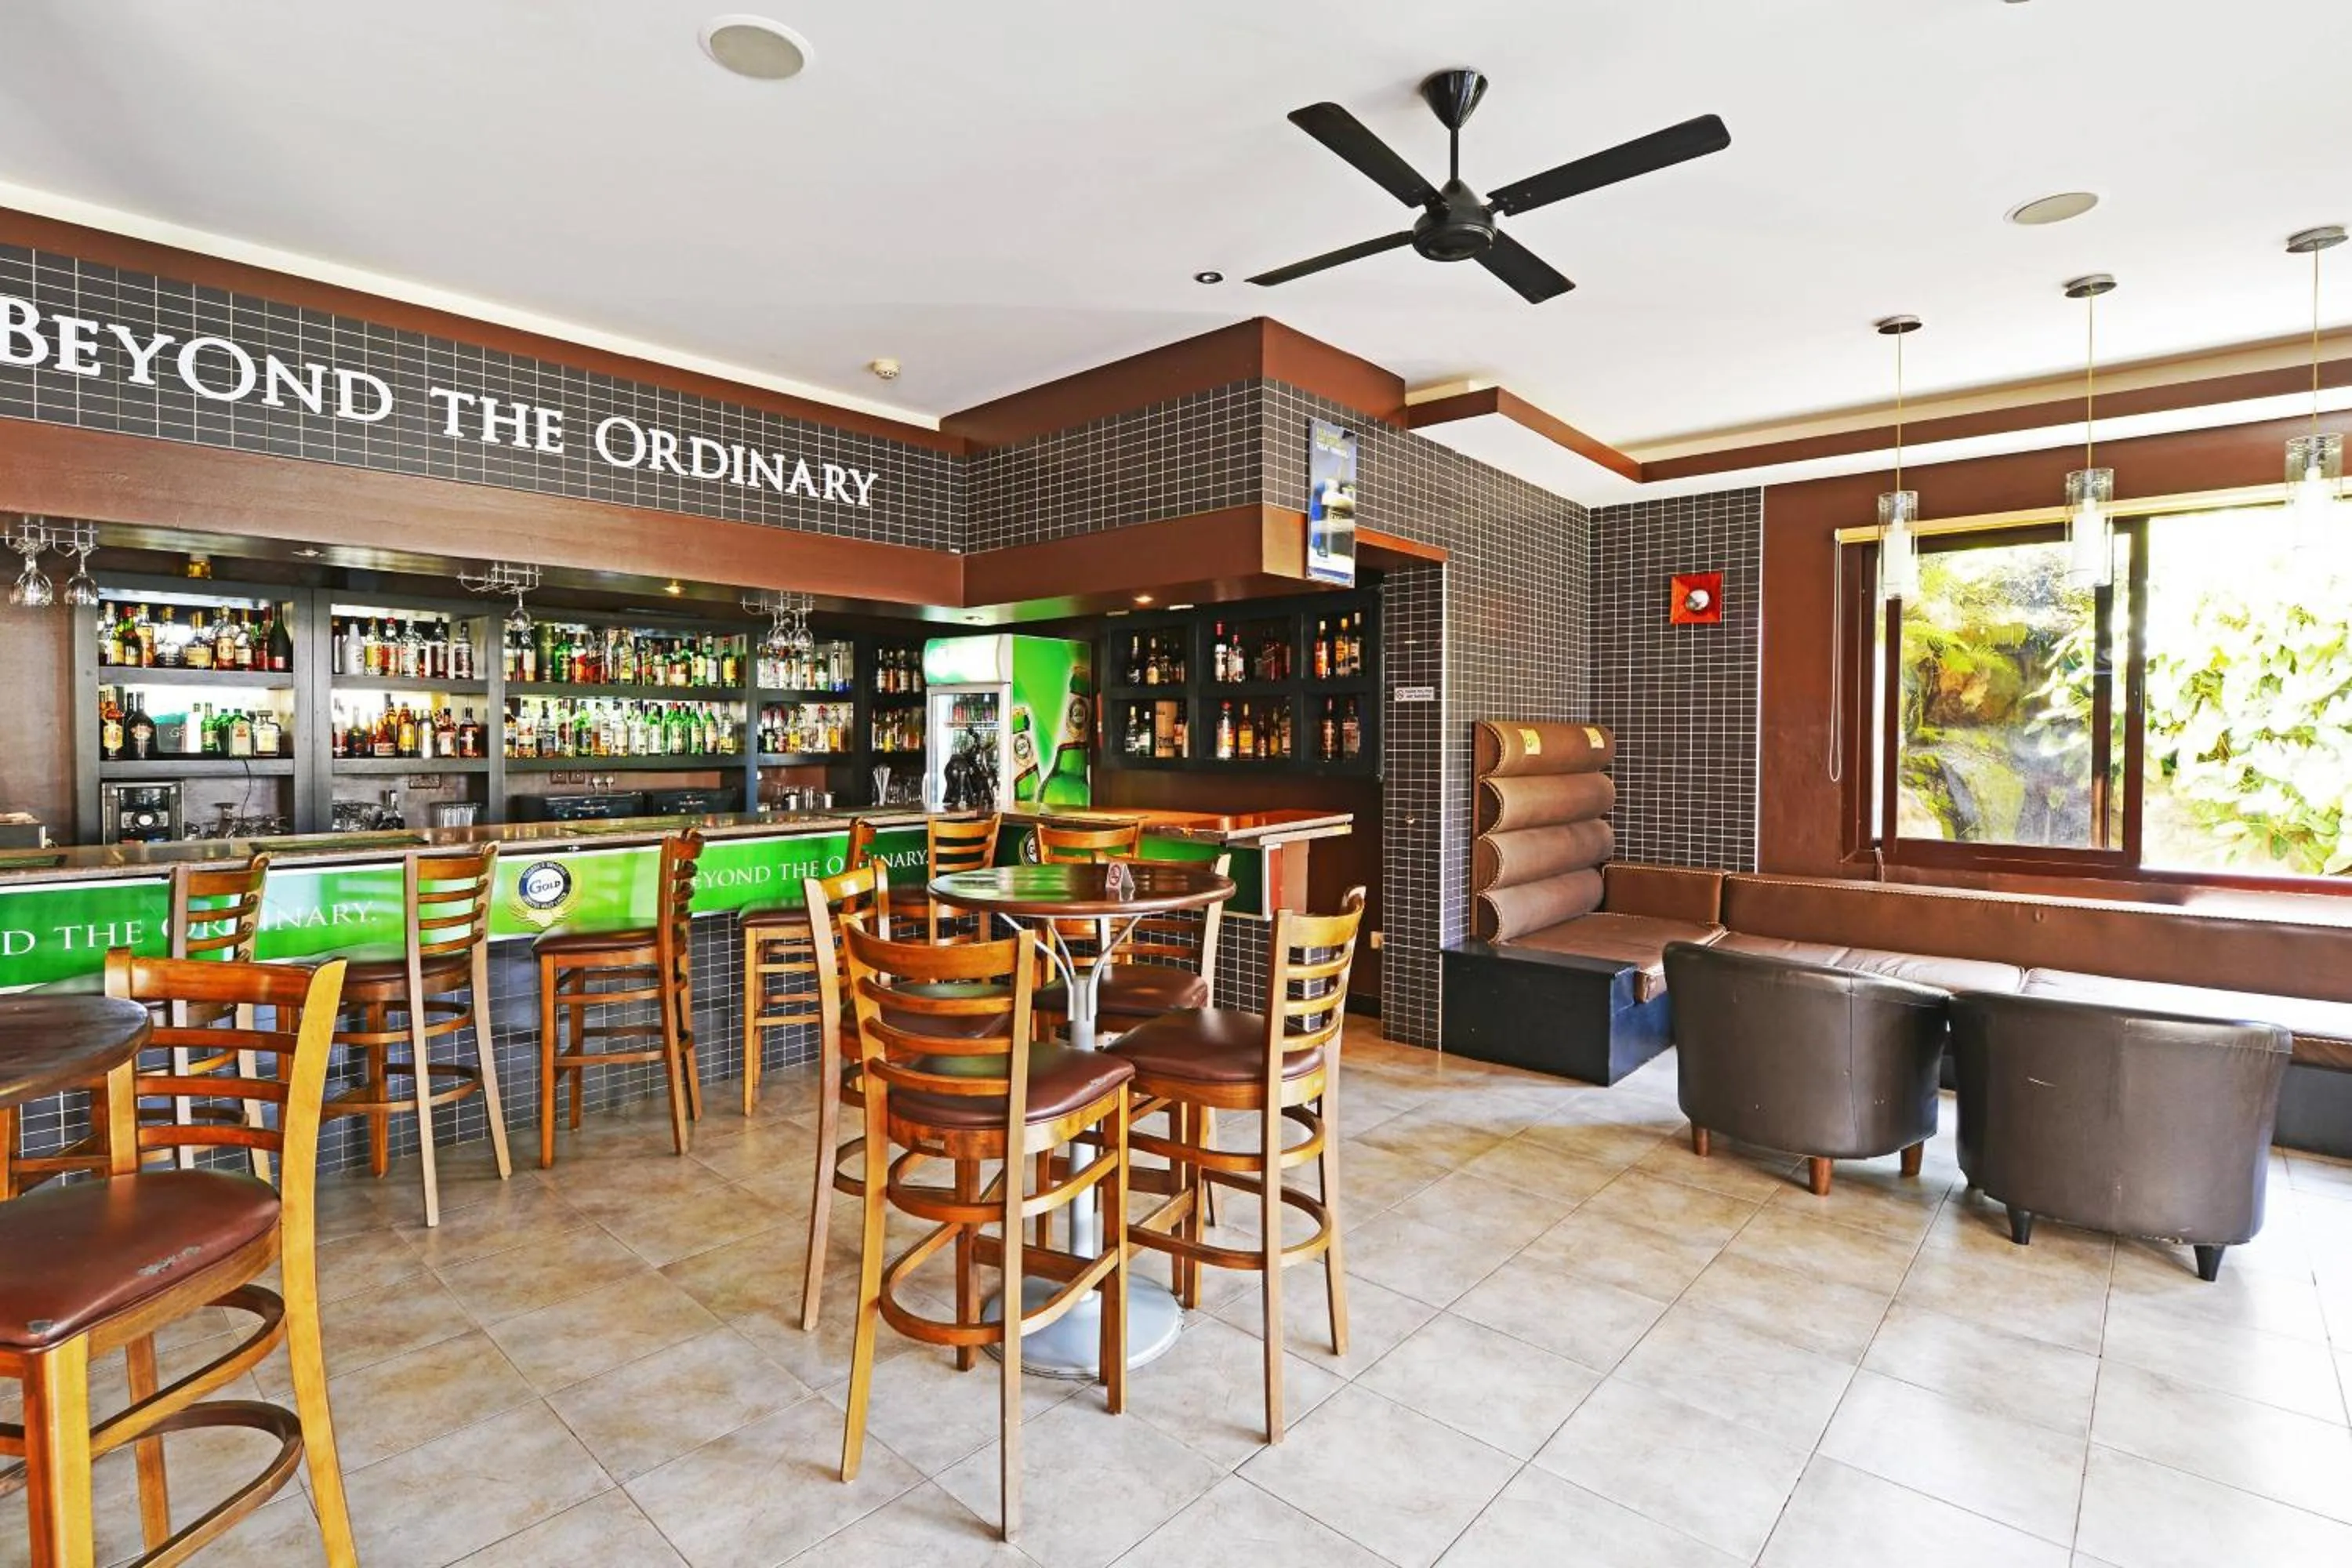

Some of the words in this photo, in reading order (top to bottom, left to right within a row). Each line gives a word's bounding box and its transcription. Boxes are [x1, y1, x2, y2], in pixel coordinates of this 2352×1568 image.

[0, 296, 393, 423] BEYOND
[430, 387, 564, 454] THE
[595, 416, 879, 507] ORDINARY
[691, 865, 771, 891] EYOND
[779, 859, 820, 881] THE
[53, 920, 143, 950] THE
